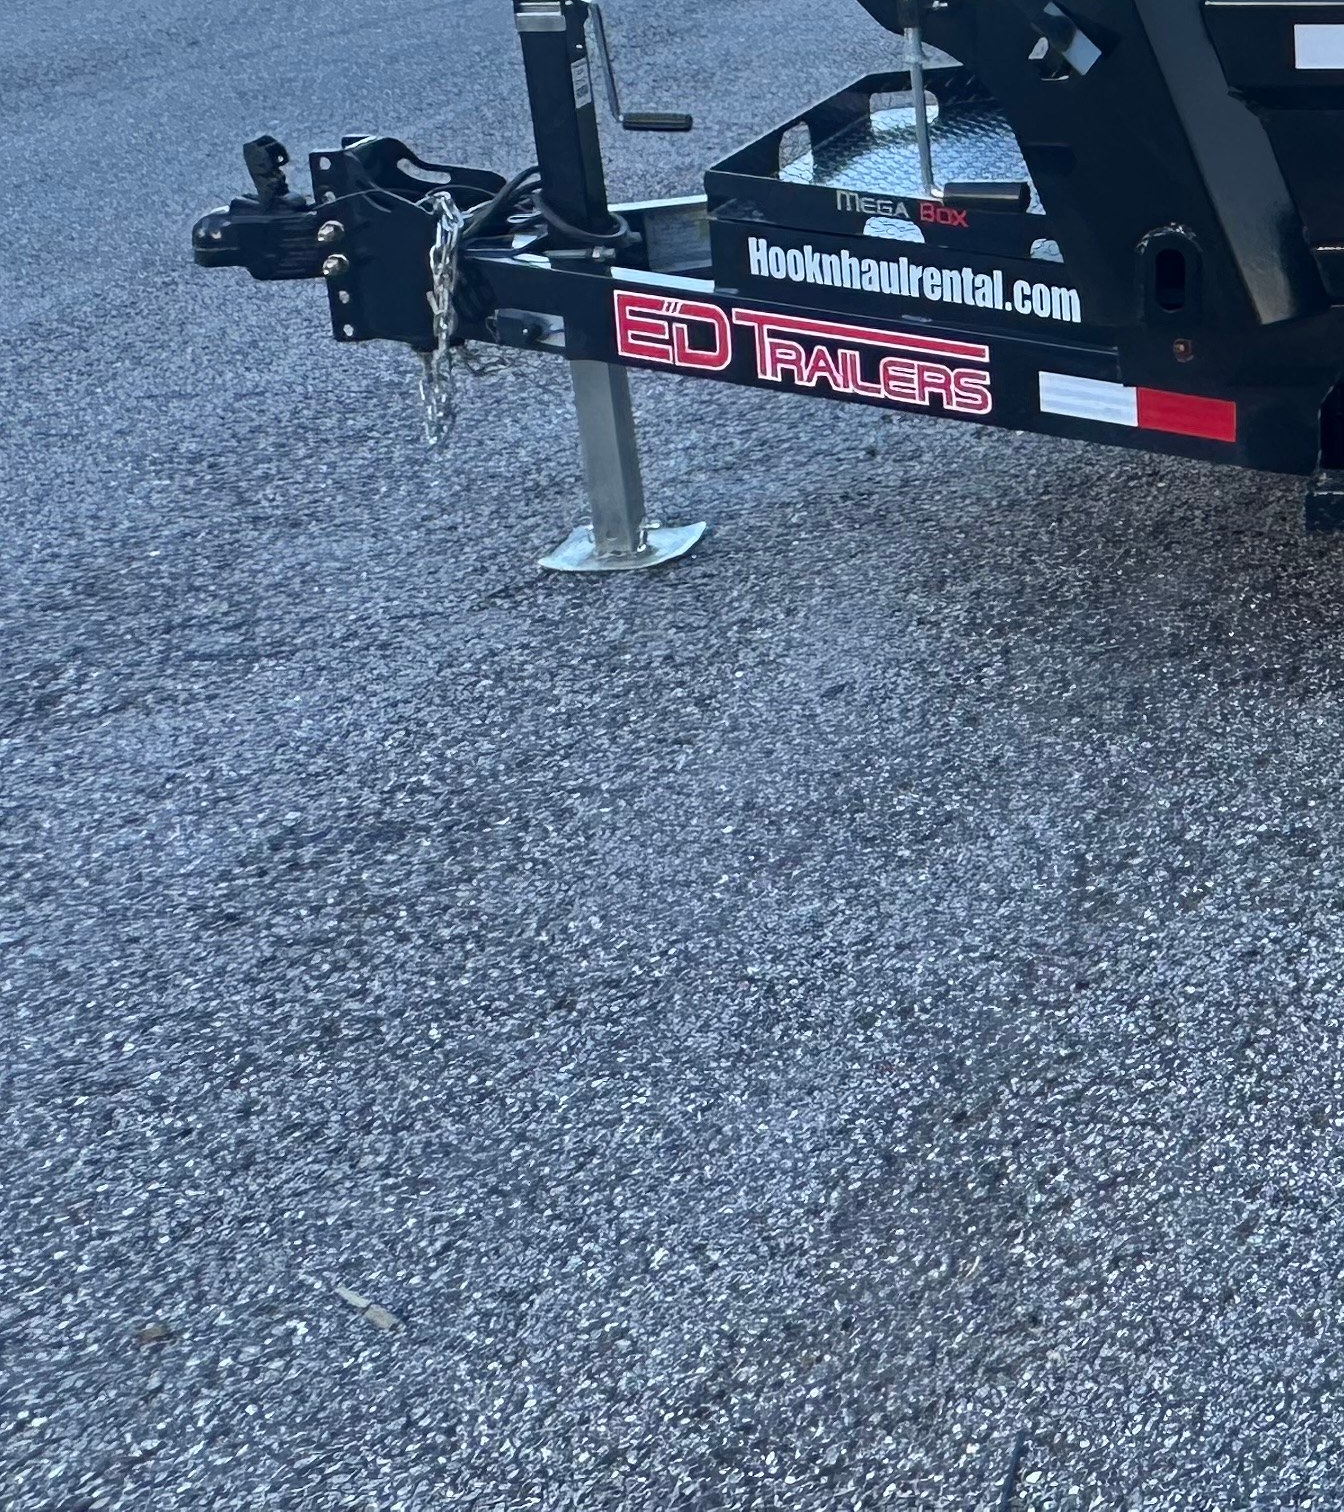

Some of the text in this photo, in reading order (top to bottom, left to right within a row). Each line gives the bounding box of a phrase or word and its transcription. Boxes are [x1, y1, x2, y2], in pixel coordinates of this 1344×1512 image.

[836, 189, 969, 228] MEGA BOX
[748, 236, 1082, 324] Hooknhaulrental.com
[732, 307, 992, 415] TRAILERS
